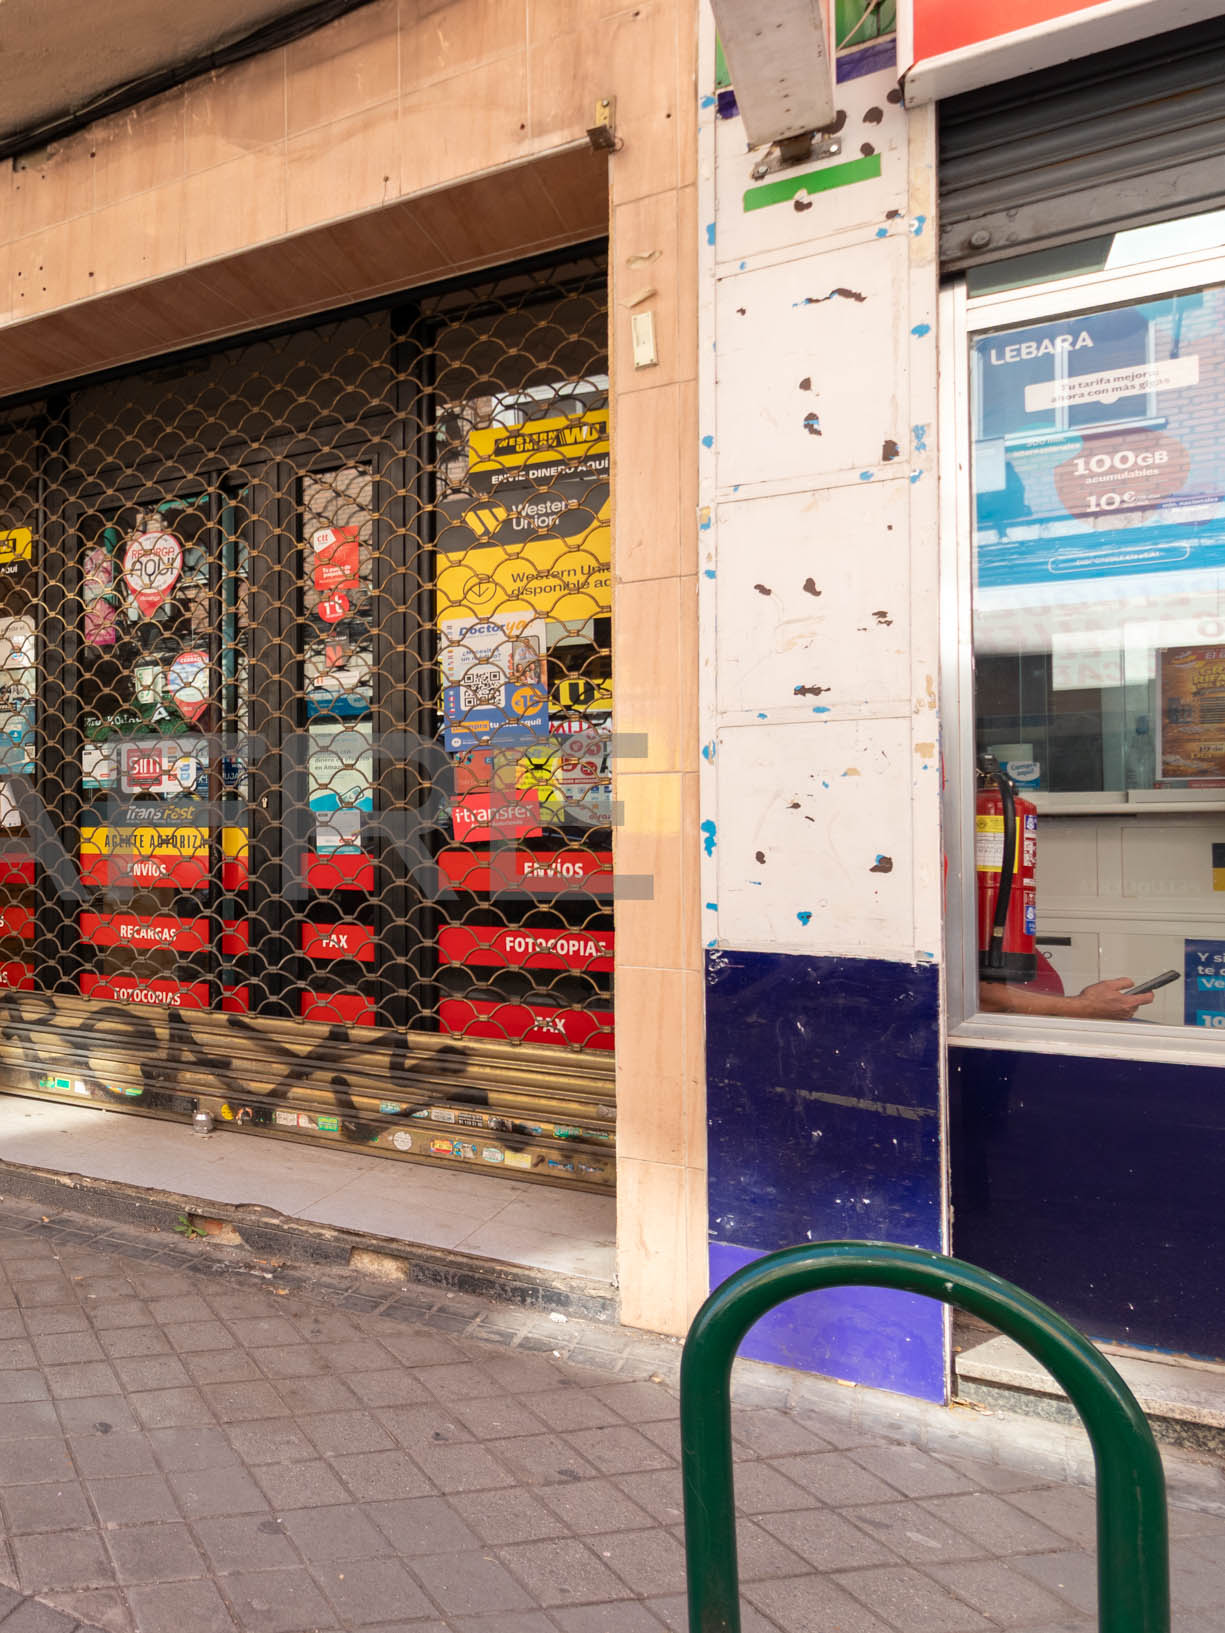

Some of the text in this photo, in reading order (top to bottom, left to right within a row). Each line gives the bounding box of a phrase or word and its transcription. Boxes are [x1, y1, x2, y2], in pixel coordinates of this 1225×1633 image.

[989, 331, 1095, 366] LEBARA
[1078, 374, 1112, 389] tarifa
[1086, 386, 1110, 398] con
[1111, 382, 1137, 394] más
[495, 431, 558, 448] WESTERN
[515, 440, 557, 452] UNION
[529, 463, 575, 479] DINERO
[577, 457, 609, 472] AQUÍ
[1073, 450, 1169, 476] 100GB
[1085, 468, 1160, 485] acumulables
[512, 498, 579, 530] Western Union
[131, 546, 175, 559] REARGA
[511, 568, 577, 583] Western
[511, 581, 590, 597] disponible
[104, 833, 145, 849] AGENTE
[126, 863, 167, 878] ENVÍOS
[523, 862, 584, 880] ENVÍOS
[119, 924, 177, 942] RECARGAS
[322, 933, 348, 949] FAX
[505, 936, 607, 958] FOTOCOPIAS
[112, 986, 181, 1006] FOTOCOPIAS
[533, 1016, 566, 1034] FAX
